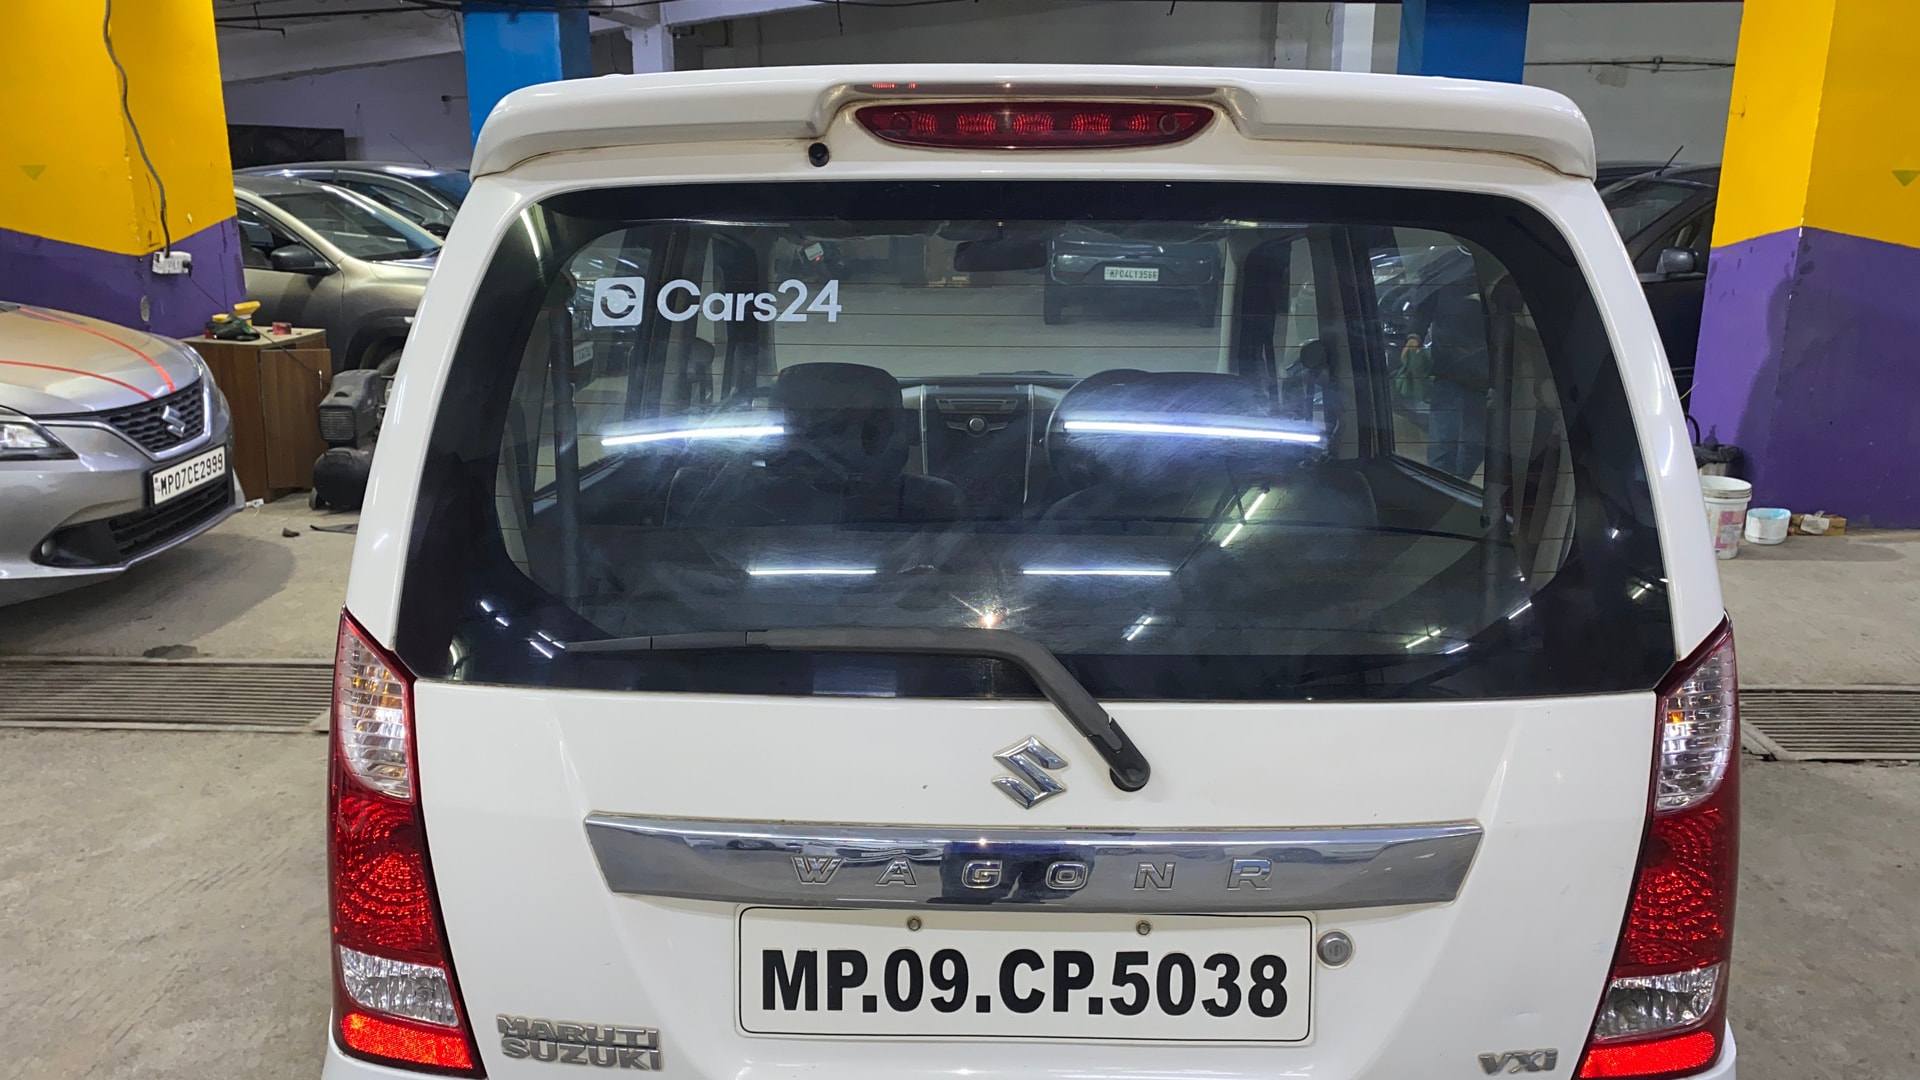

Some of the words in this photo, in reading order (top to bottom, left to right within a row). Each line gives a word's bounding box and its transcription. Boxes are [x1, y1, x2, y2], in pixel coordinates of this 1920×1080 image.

[656, 278, 842, 323] Cars24
[160, 453, 224, 497] MP07CE2999
[761, 948, 1288, 1018] MP.09.CP.5038
[496, 1015, 660, 1049] MARUTI
[501, 1036, 662, 1071] SUZUKI
